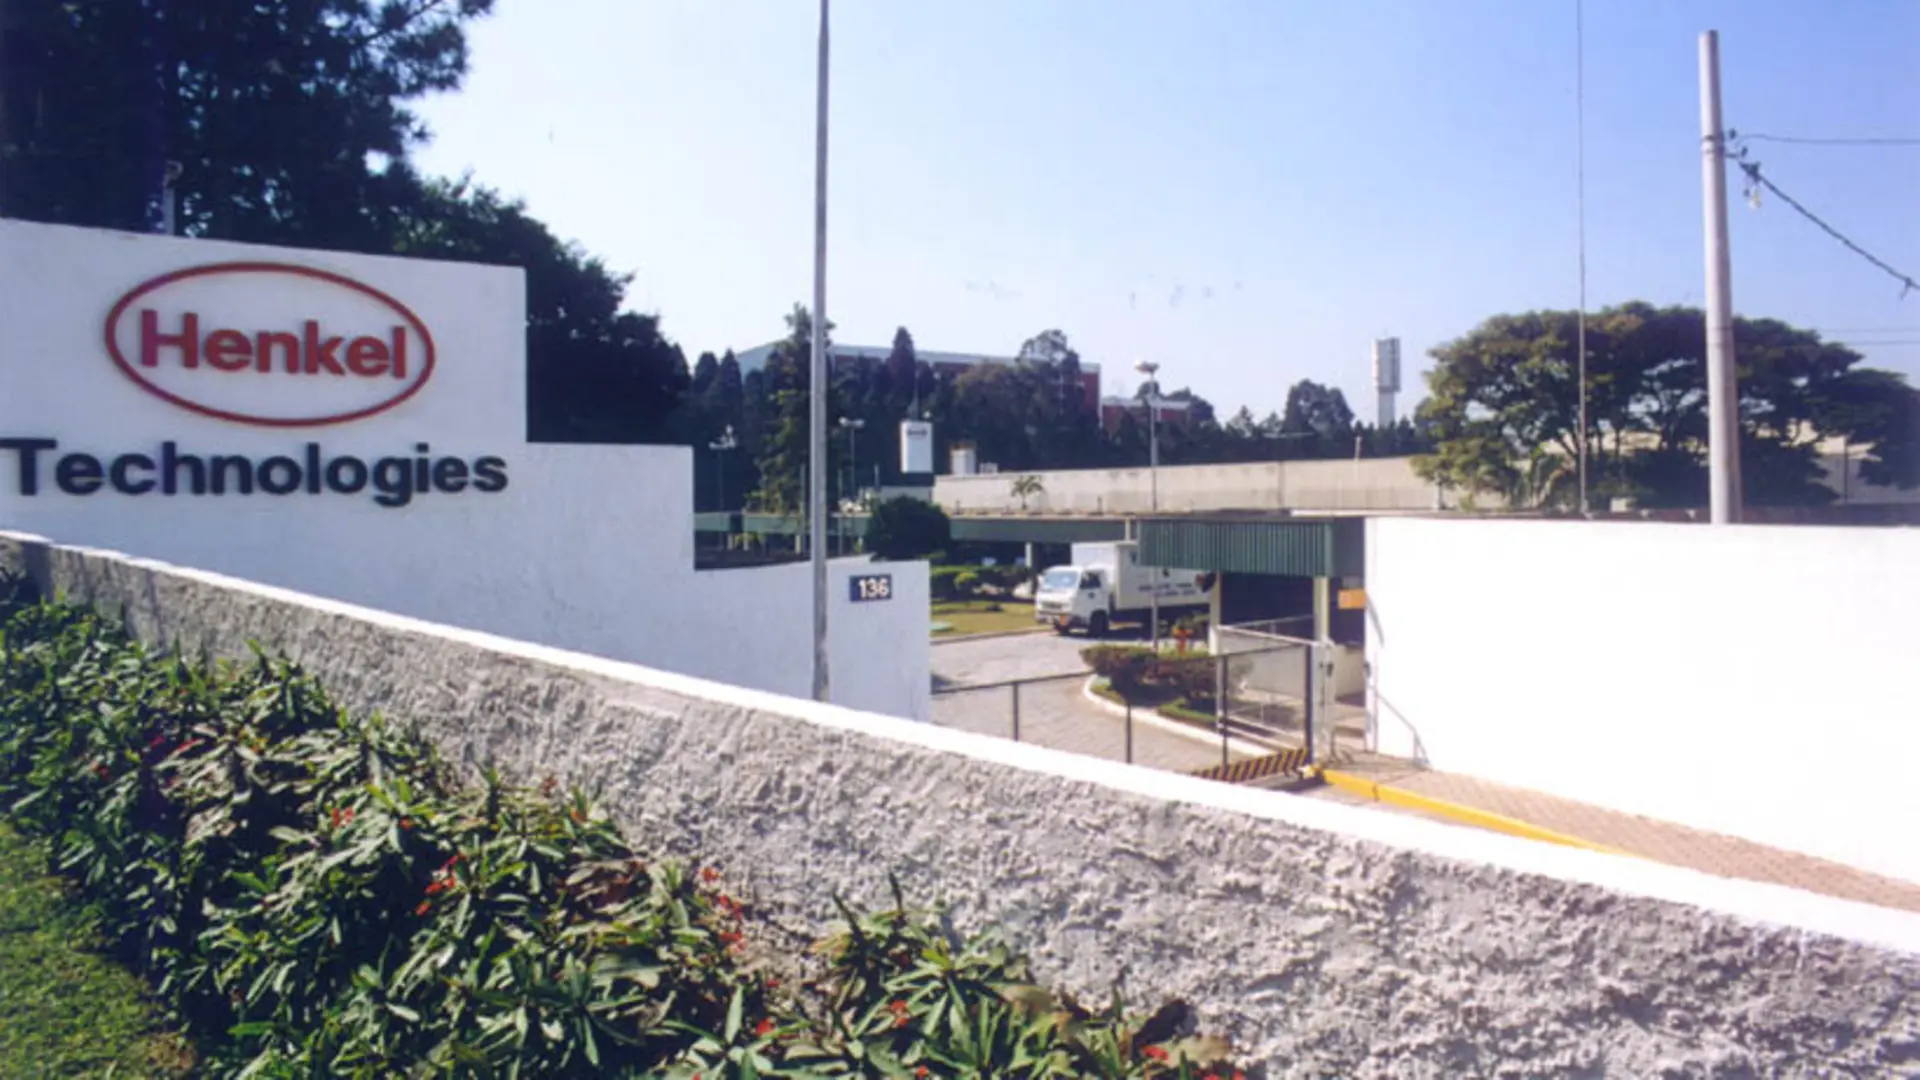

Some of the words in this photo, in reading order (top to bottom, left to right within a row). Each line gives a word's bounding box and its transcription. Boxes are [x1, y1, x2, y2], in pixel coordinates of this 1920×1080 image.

[139, 309, 408, 379] Henkel
[0, 437, 508, 507] Technologies
[859, 578, 890, 598] 136
